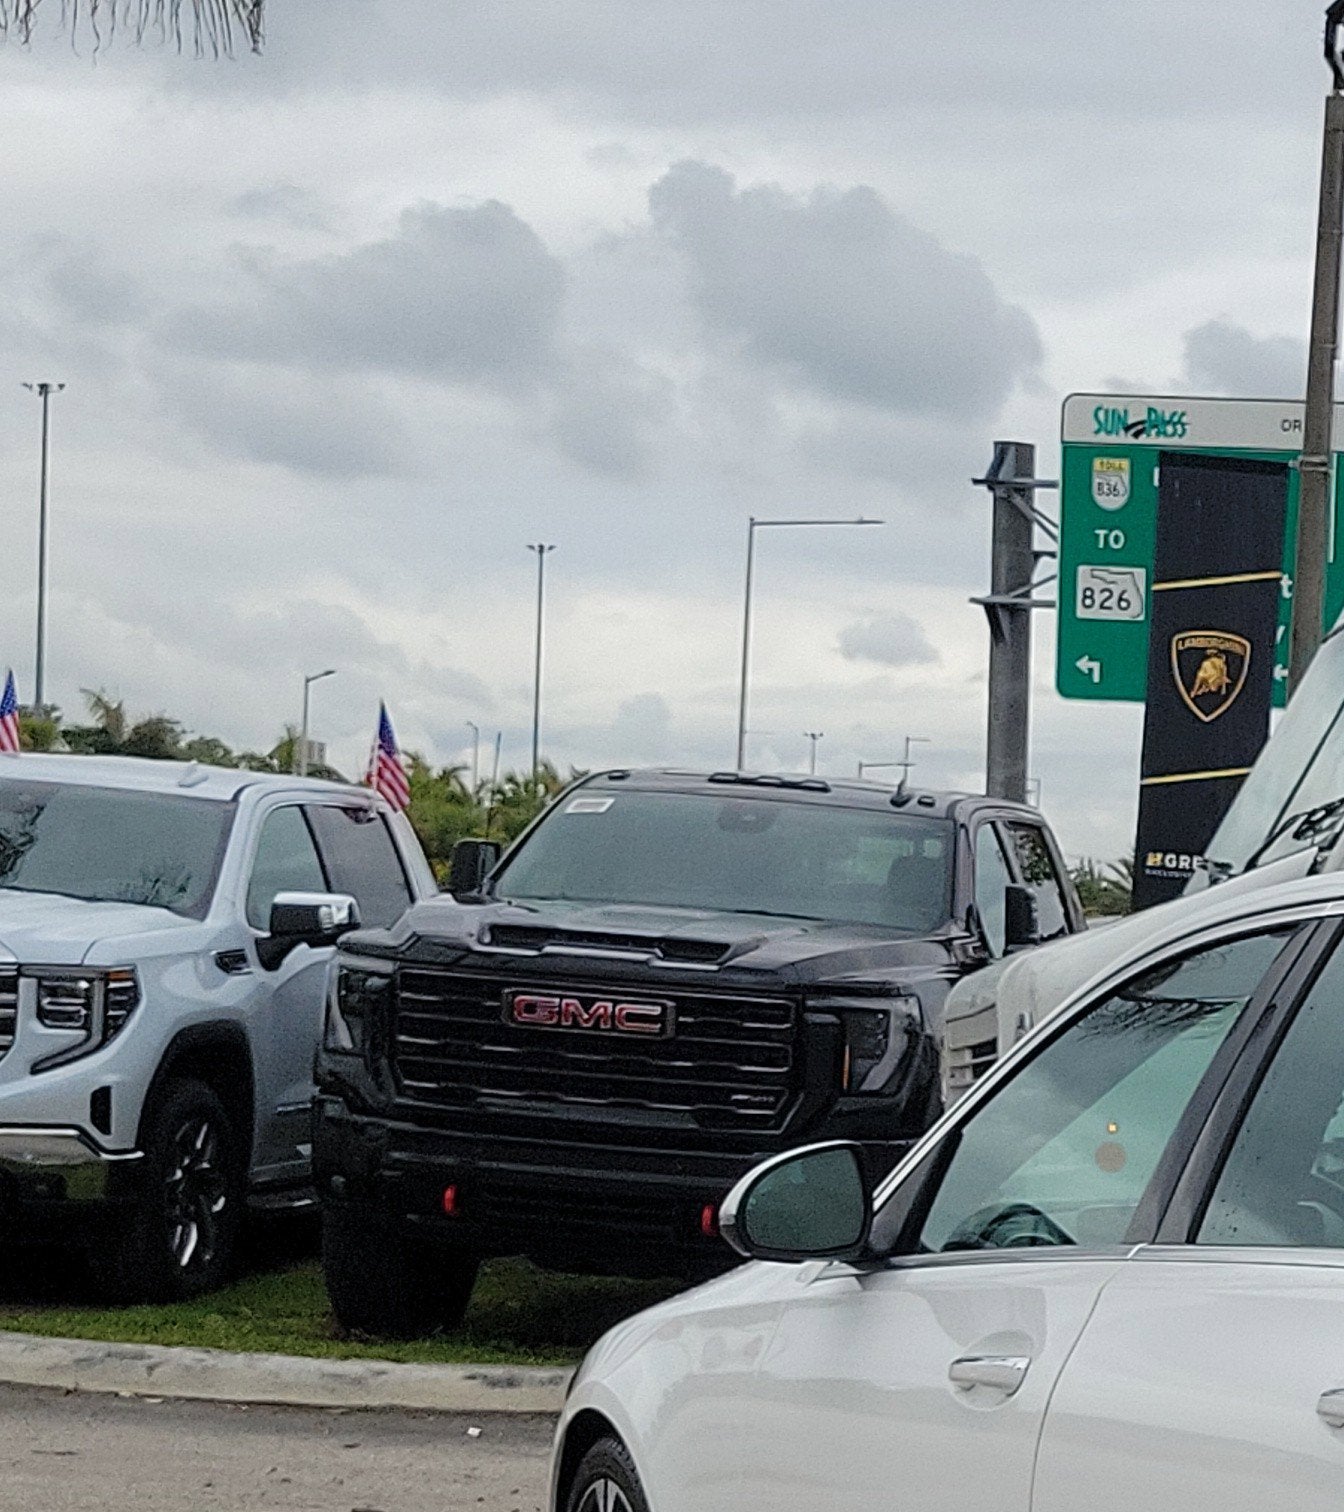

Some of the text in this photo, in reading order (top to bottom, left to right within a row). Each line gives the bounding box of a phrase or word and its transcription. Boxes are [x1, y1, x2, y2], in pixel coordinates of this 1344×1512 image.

[1281, 418, 1302, 432] OR
[1094, 529, 1126, 549] TO
[1080, 586, 1132, 611] 826
[514, 994, 663, 1033] GMC
